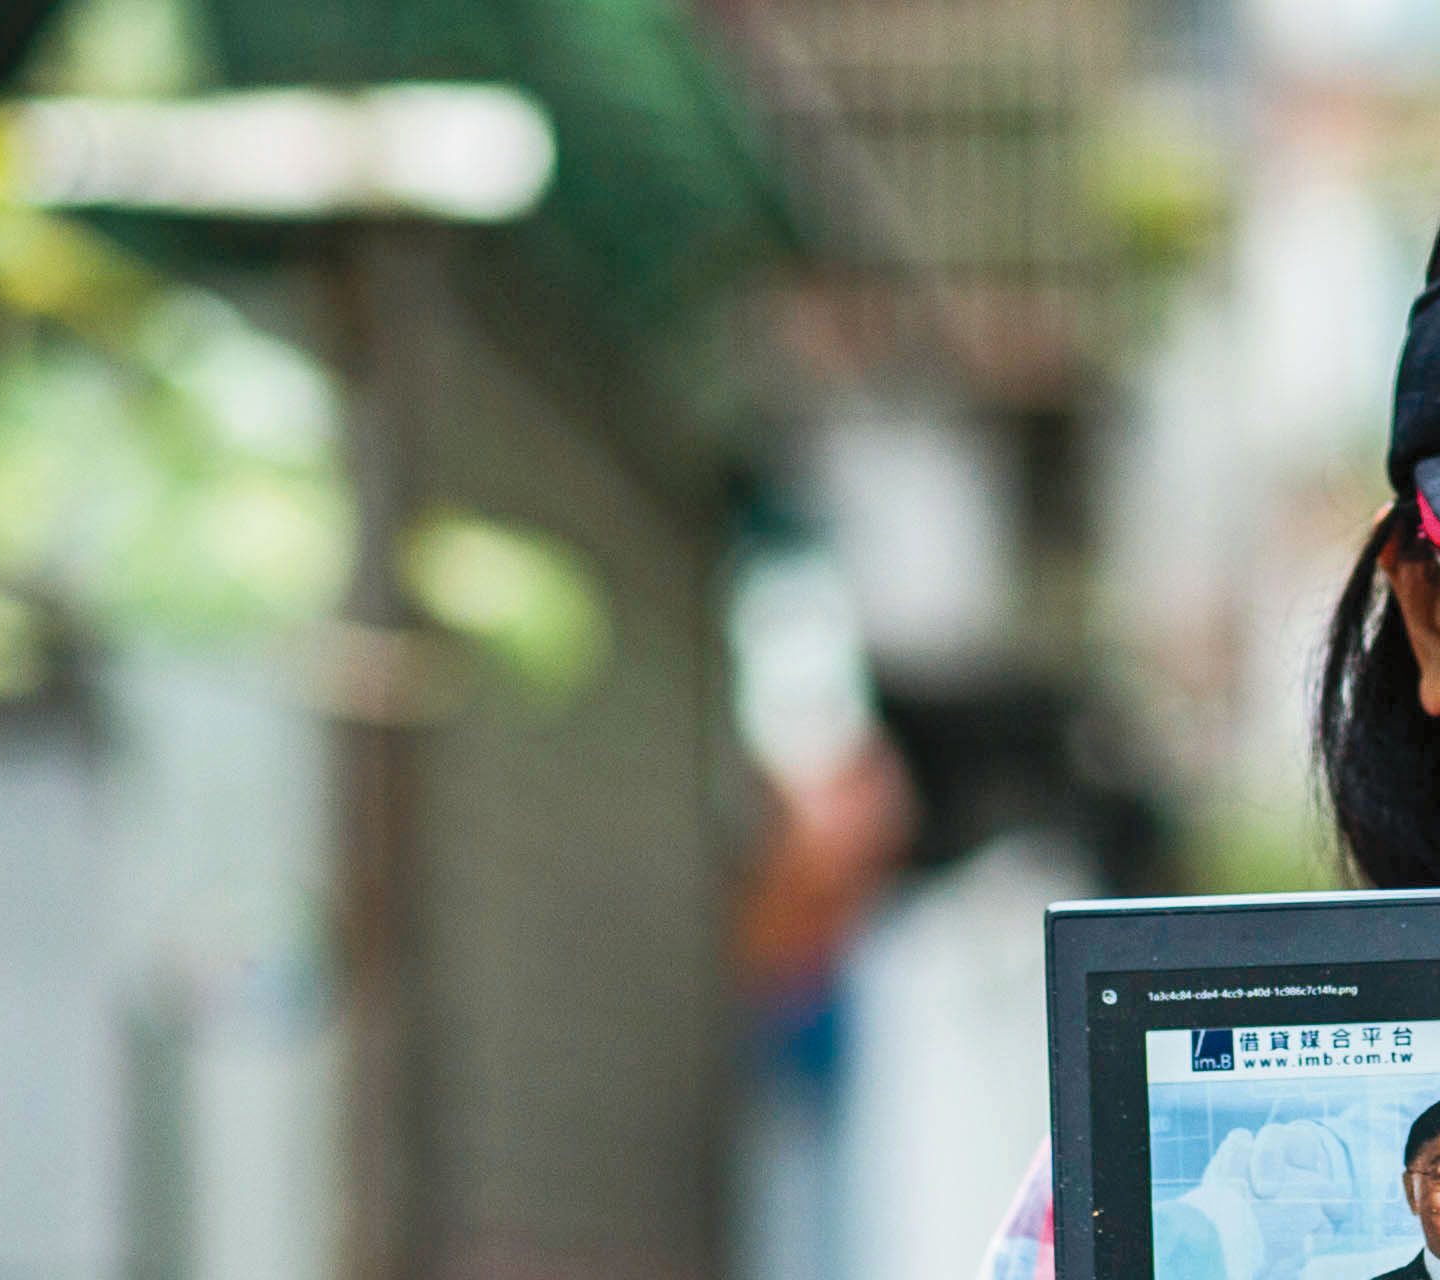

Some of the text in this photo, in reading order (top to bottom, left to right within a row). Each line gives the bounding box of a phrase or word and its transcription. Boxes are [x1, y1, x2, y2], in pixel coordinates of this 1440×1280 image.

[1239, 1026, 1413, 1052] 借貸媒合平台
[1243, 1051, 1413, 1069] www.imb.com.tw
